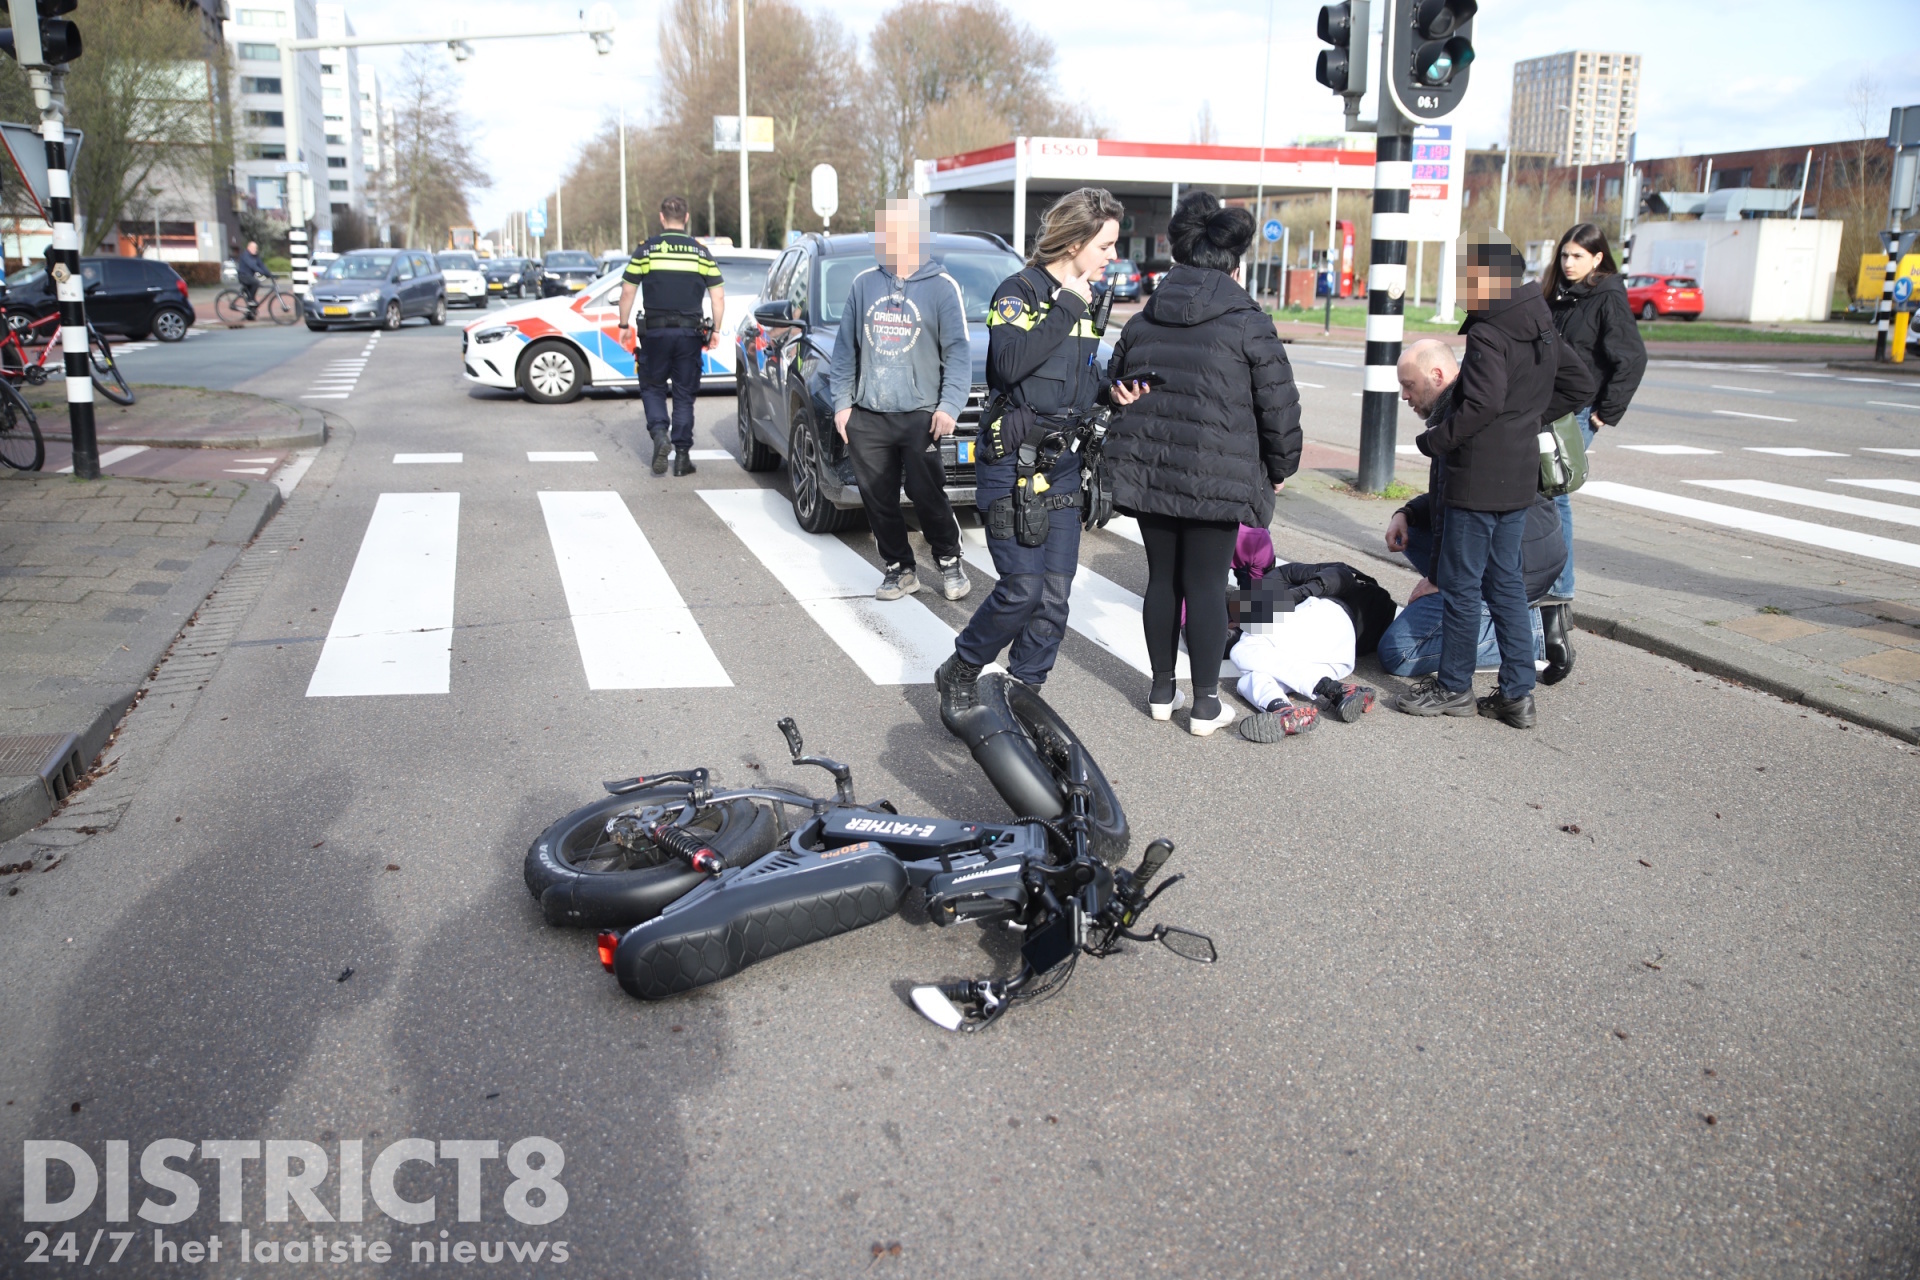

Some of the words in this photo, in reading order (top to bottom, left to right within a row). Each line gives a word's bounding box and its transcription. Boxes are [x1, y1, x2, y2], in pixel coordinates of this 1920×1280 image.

[1417, 95, 1439, 108] 06.1
[1041, 143, 1088, 156] ESSO
[656, 243, 693, 252] POLITIE
[874, 311, 912, 324] ORIGINAL
[845, 817, 937, 837] E-FATHER
